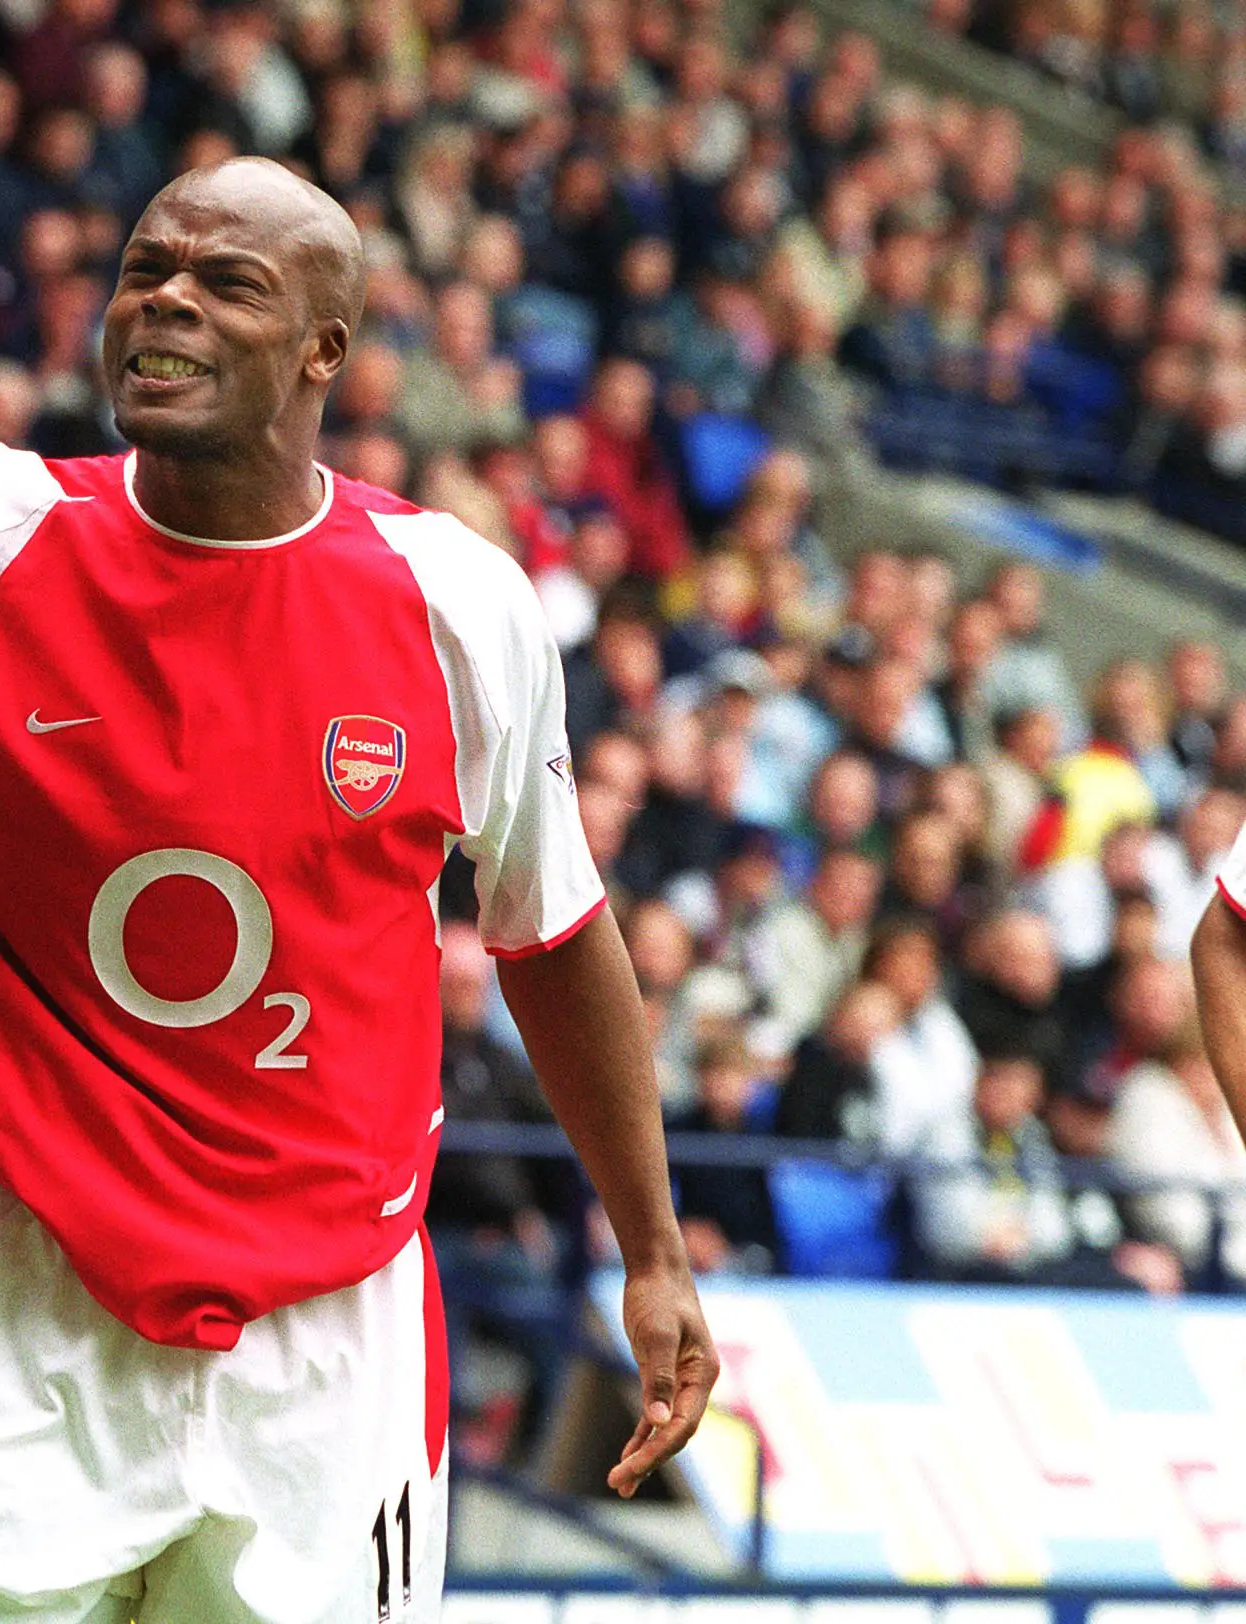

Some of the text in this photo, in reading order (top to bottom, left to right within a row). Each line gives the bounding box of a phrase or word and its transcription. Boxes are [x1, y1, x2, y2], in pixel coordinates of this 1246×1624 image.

[337, 735, 393, 757] Arsenal
[88, 848, 311, 1069] O2
[371, 1479, 411, 1624] 11
